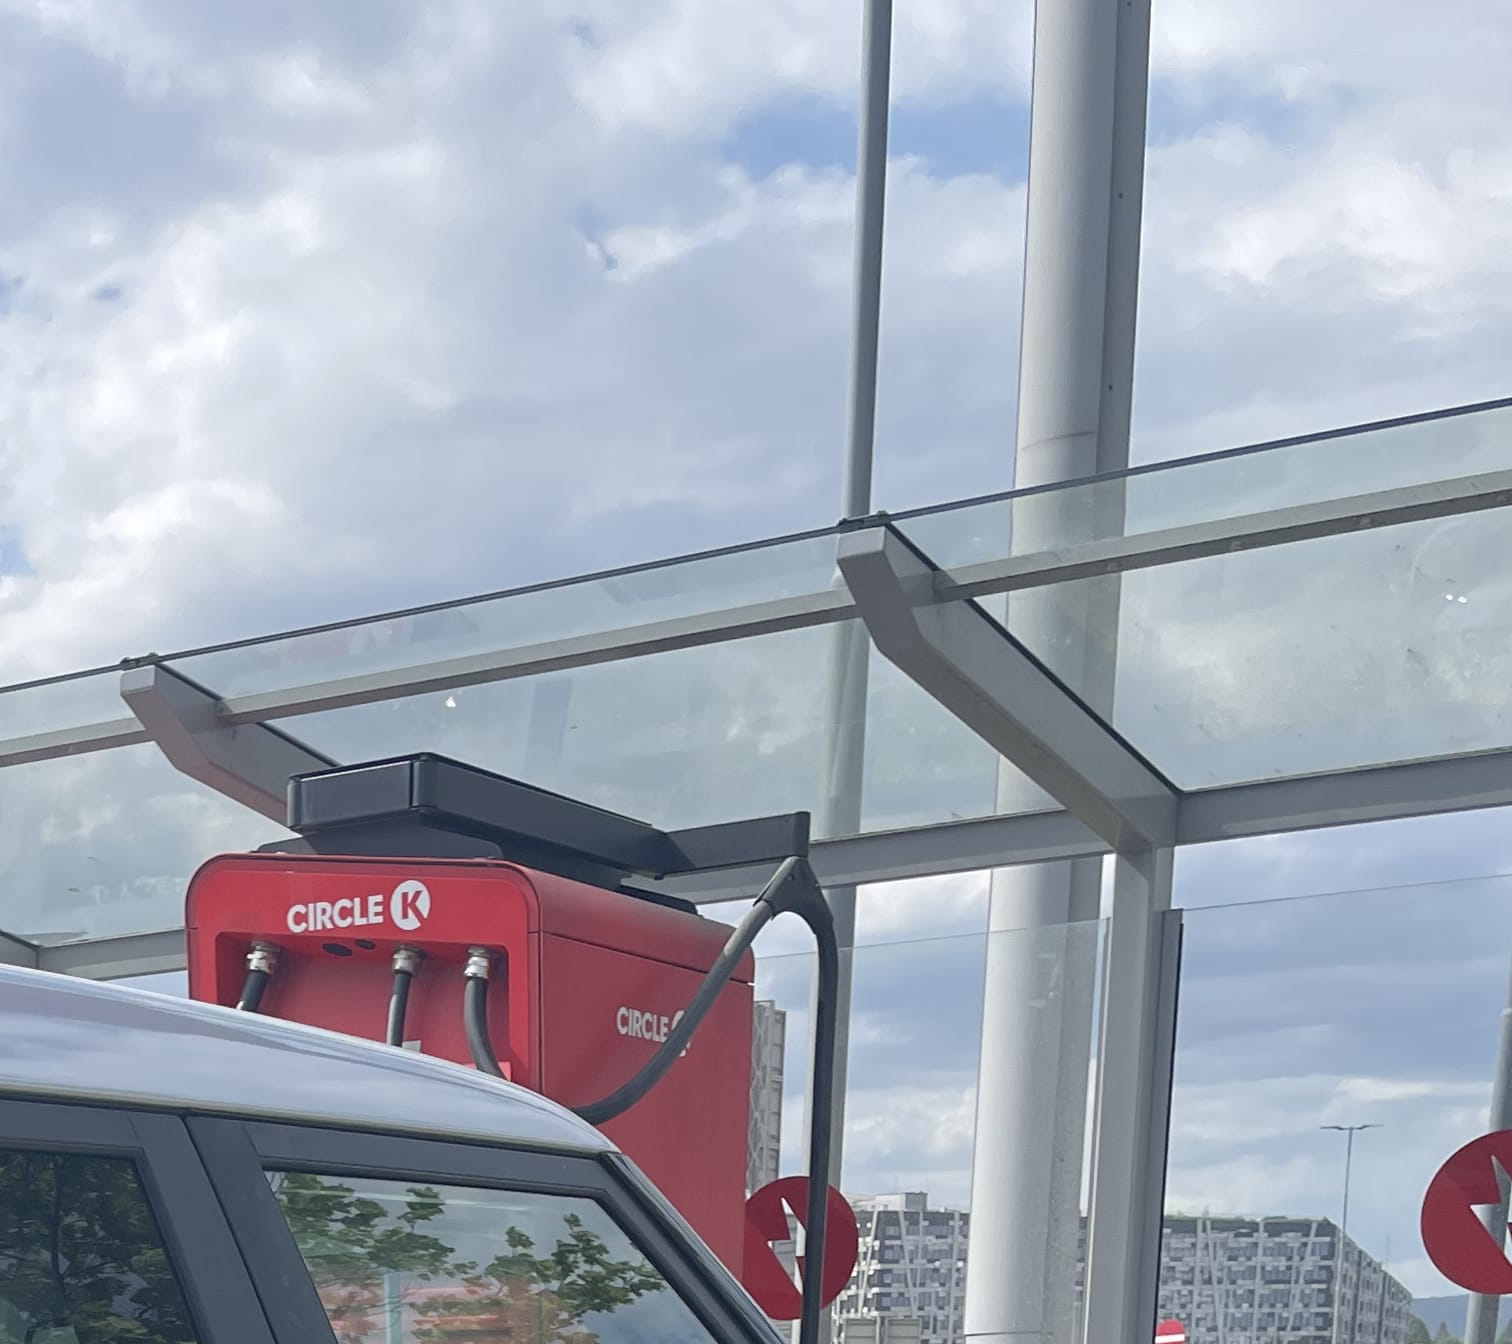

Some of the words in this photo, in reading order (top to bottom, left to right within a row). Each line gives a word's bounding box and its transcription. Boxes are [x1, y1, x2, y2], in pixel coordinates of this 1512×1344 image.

[286, 894, 384, 933] CIRCLE
[389, 879, 431, 931] K
[616, 1006, 669, 1043] CIRCLE
